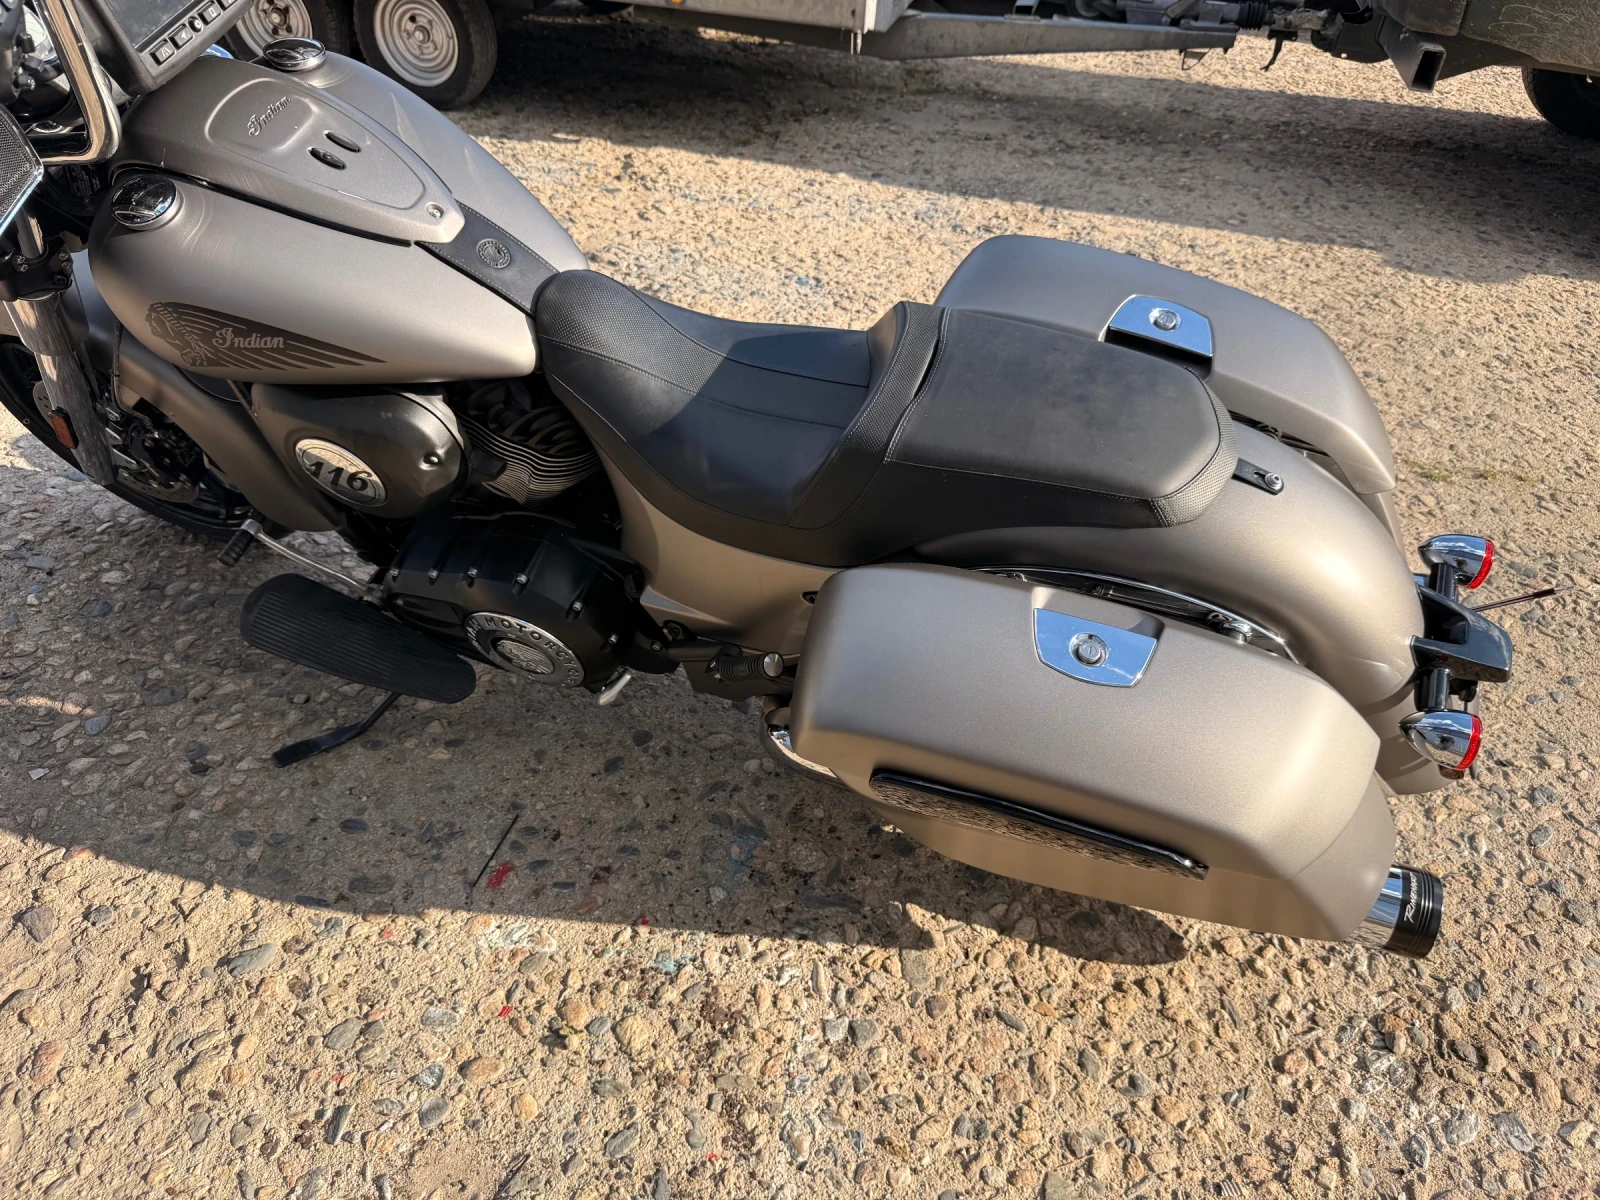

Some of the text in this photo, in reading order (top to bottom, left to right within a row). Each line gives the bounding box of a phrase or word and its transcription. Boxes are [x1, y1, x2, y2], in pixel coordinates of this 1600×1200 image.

[247, 96, 291, 136] Indian
[212, 327, 285, 349] Indian
[309, 461, 373, 492] 116
